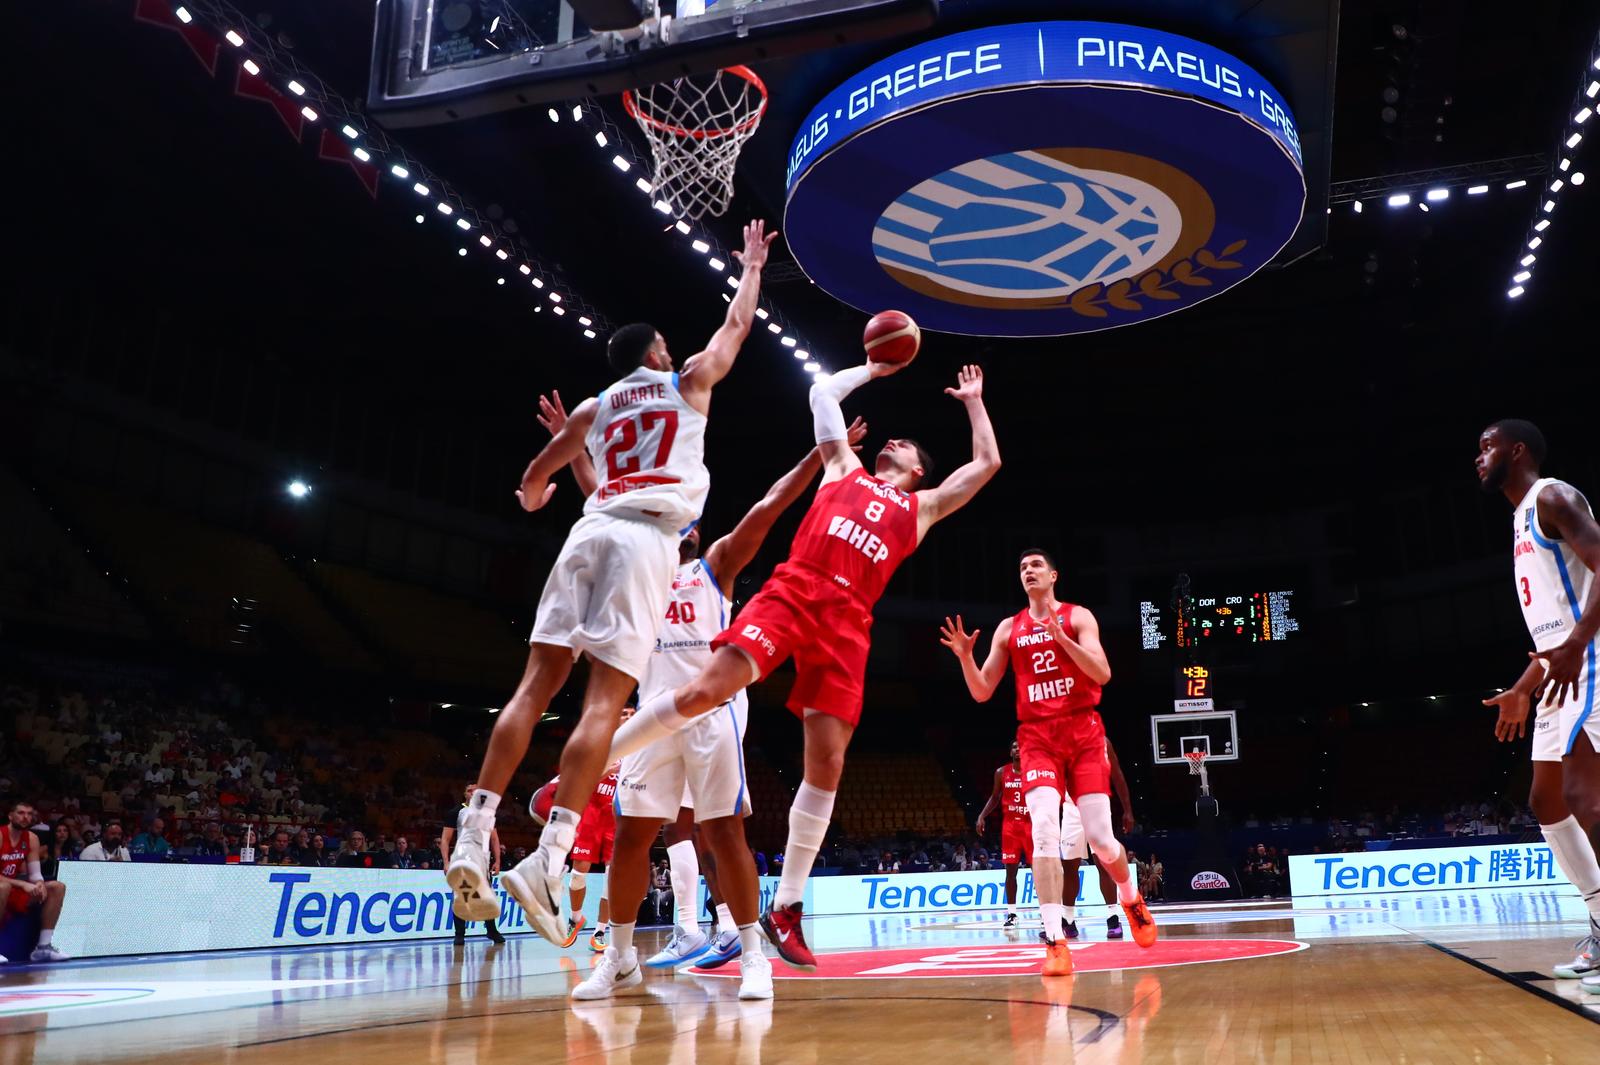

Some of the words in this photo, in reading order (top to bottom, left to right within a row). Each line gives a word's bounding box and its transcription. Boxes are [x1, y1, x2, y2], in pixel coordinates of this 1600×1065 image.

[1078, 37, 1242, 98] PIRAEUS
[848, 43, 1001, 120] GREECE
[1260, 89, 1303, 165] GREE
[610, 383, 665, 410] DUARTE
[604, 411, 678, 481] 27
[855, 476, 910, 511] HRVATSKA
[864, 501, 886, 522] 8
[848, 524, 889, 564] HEP
[1199, 598, 1216, 606] DOM
[1225, 596, 1242, 605] CRO
[1520, 577, 1532, 607] 3
[665, 601, 696, 624] 40
[1220, 619, 1225, 627] 2
[1234, 617, 1244, 626] 25
[1017, 631, 1053, 648] HRVATS
[1032, 650, 1059, 674] 22
[1042, 677, 1074, 699] HEP
[1187, 679, 1206, 696] 12
[1037, 770, 1056, 779] HPB
[1014, 791, 1021, 803] 3
[1314, 855, 1483, 890] Tencent
[1488, 847, 1557, 882] 腾讯
